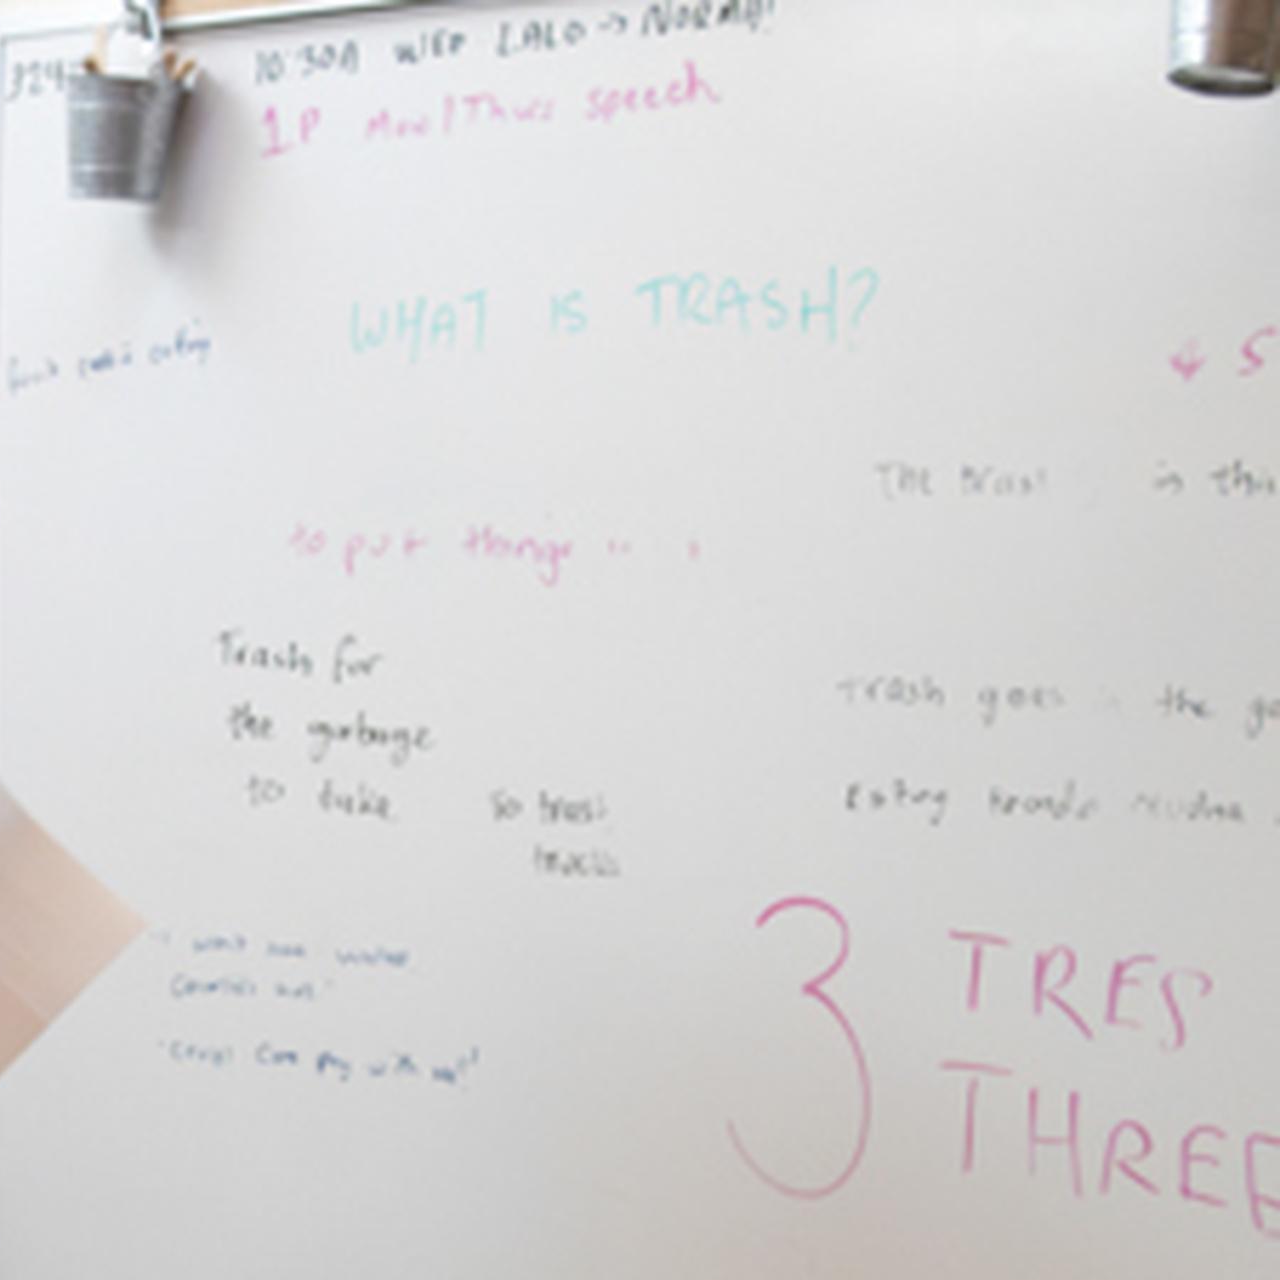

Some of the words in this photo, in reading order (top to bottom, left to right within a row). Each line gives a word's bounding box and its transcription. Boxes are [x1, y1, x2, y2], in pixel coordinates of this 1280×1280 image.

[585, 59, 721, 122] speech
[349, 290, 489, 362] WHAT
[548, 291, 590, 336] IS
[635, 265, 882, 353] TRASH?
[215, 627, 315, 676] Trash
[332, 632, 384, 685] for
[306, 711, 437, 767] garbage
[948, 927, 1215, 1054] TRES
[727, 895, 872, 1202] 3
[939, 1060, 1280, 1242] THREE
